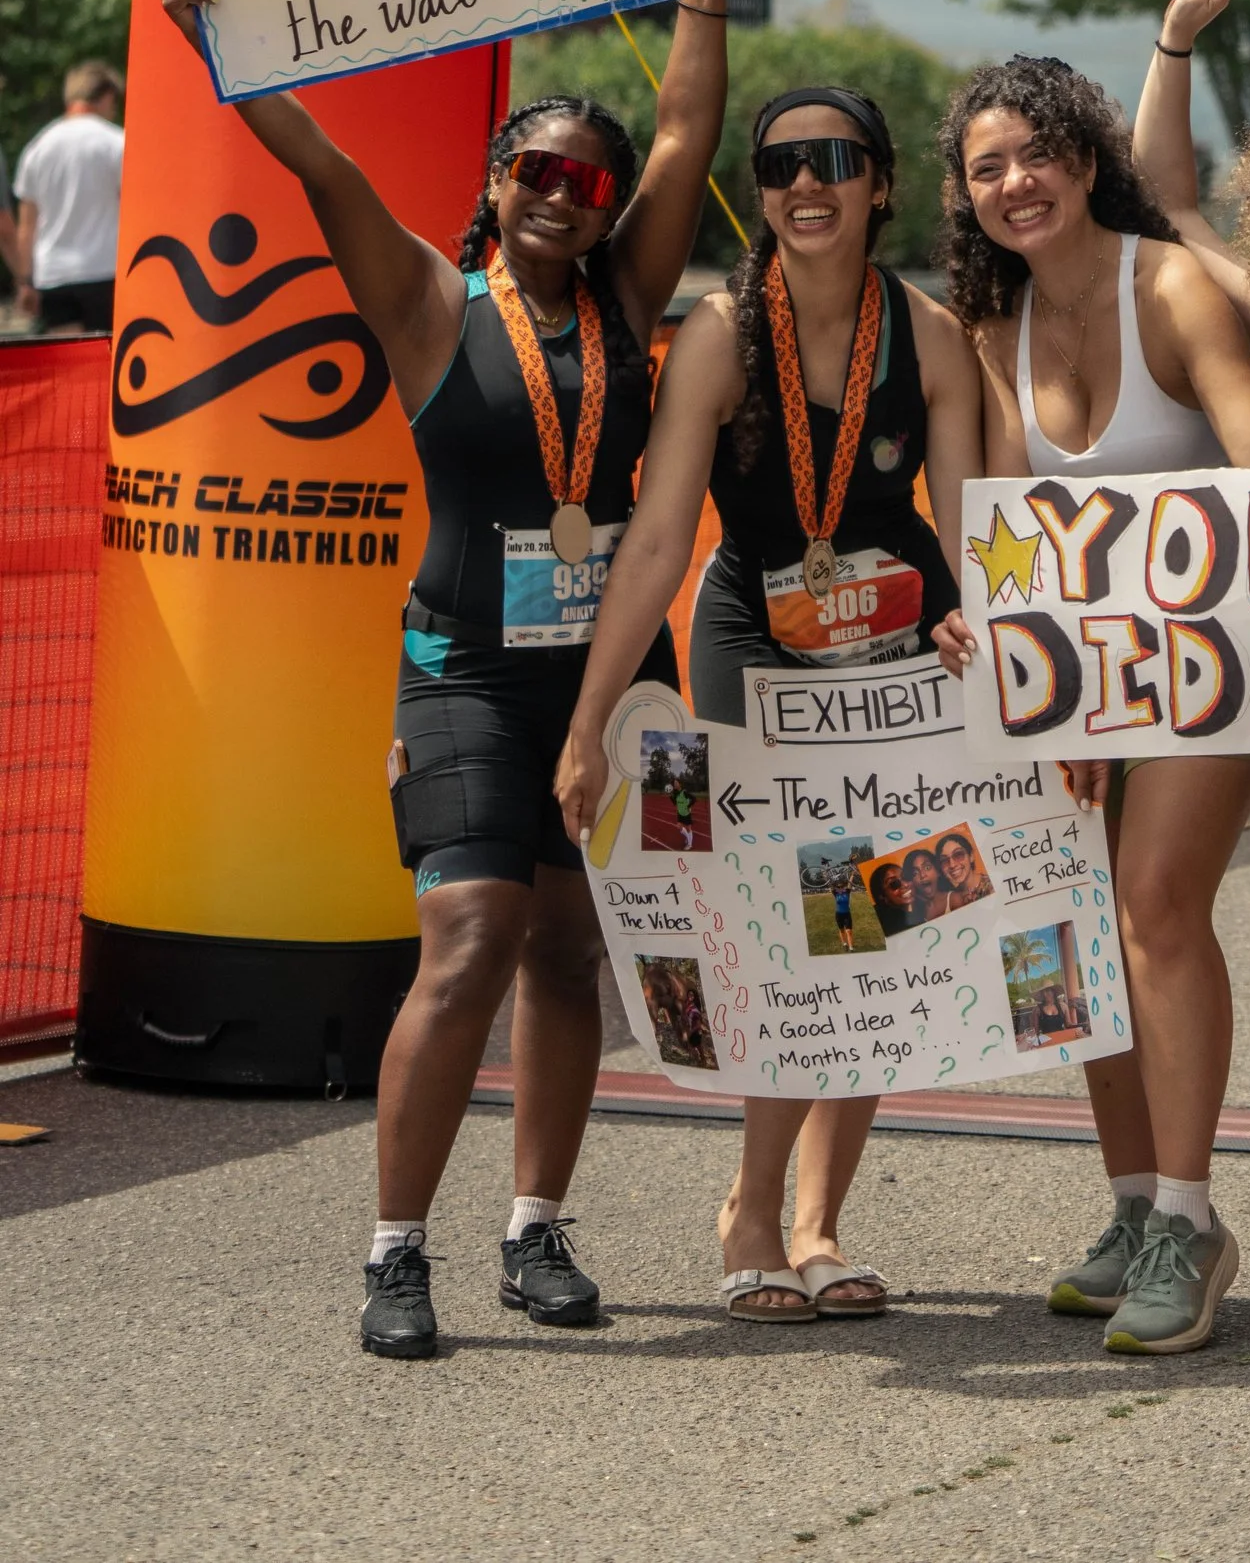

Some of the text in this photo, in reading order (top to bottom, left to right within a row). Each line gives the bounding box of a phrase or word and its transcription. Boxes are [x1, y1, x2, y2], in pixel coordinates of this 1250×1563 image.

[104, 463, 409, 520] EACH CLASSIC
[212, 526, 400, 567] TRIATHLON
[507, 542, 522, 552] July
[538, 542, 554, 552] 202
[552, 561, 609, 600] 939
[815, 584, 878, 626] 306
[829, 623, 871, 645] MEENA
[988, 611, 1247, 738] DID
[776, 674, 949, 734] EXHIBIT
[773, 761, 1044, 821] The Mastermind
[992, 820, 1080, 866] Forced 4
[416, 867, 441, 900] tic
[605, 881, 680, 906] Down 4
[1003, 857, 1089, 896] The Ride
[616, 911, 693, 931] The Vibes
[759, 966, 953, 1015] Thought This Was
[759, 999, 931, 1039] A Good Idea 4
[779, 1046, 860, 1069] Months
